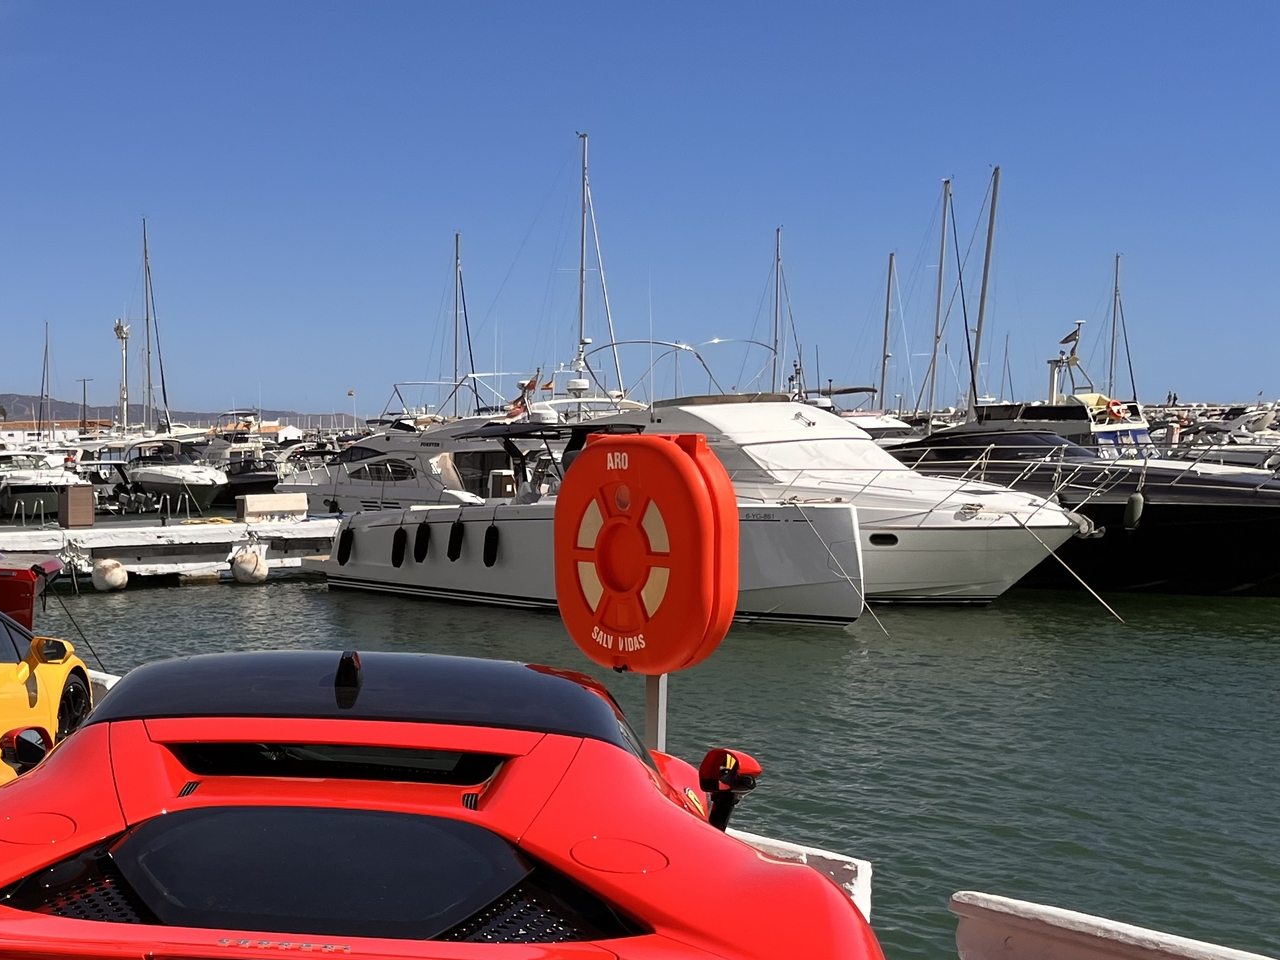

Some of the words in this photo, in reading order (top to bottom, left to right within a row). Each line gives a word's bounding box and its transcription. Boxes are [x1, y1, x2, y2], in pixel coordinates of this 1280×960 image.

[606, 452, 629, 471] ARO
[591, 626, 613, 650] SALV
[618, 633, 646, 652] VIDAS
